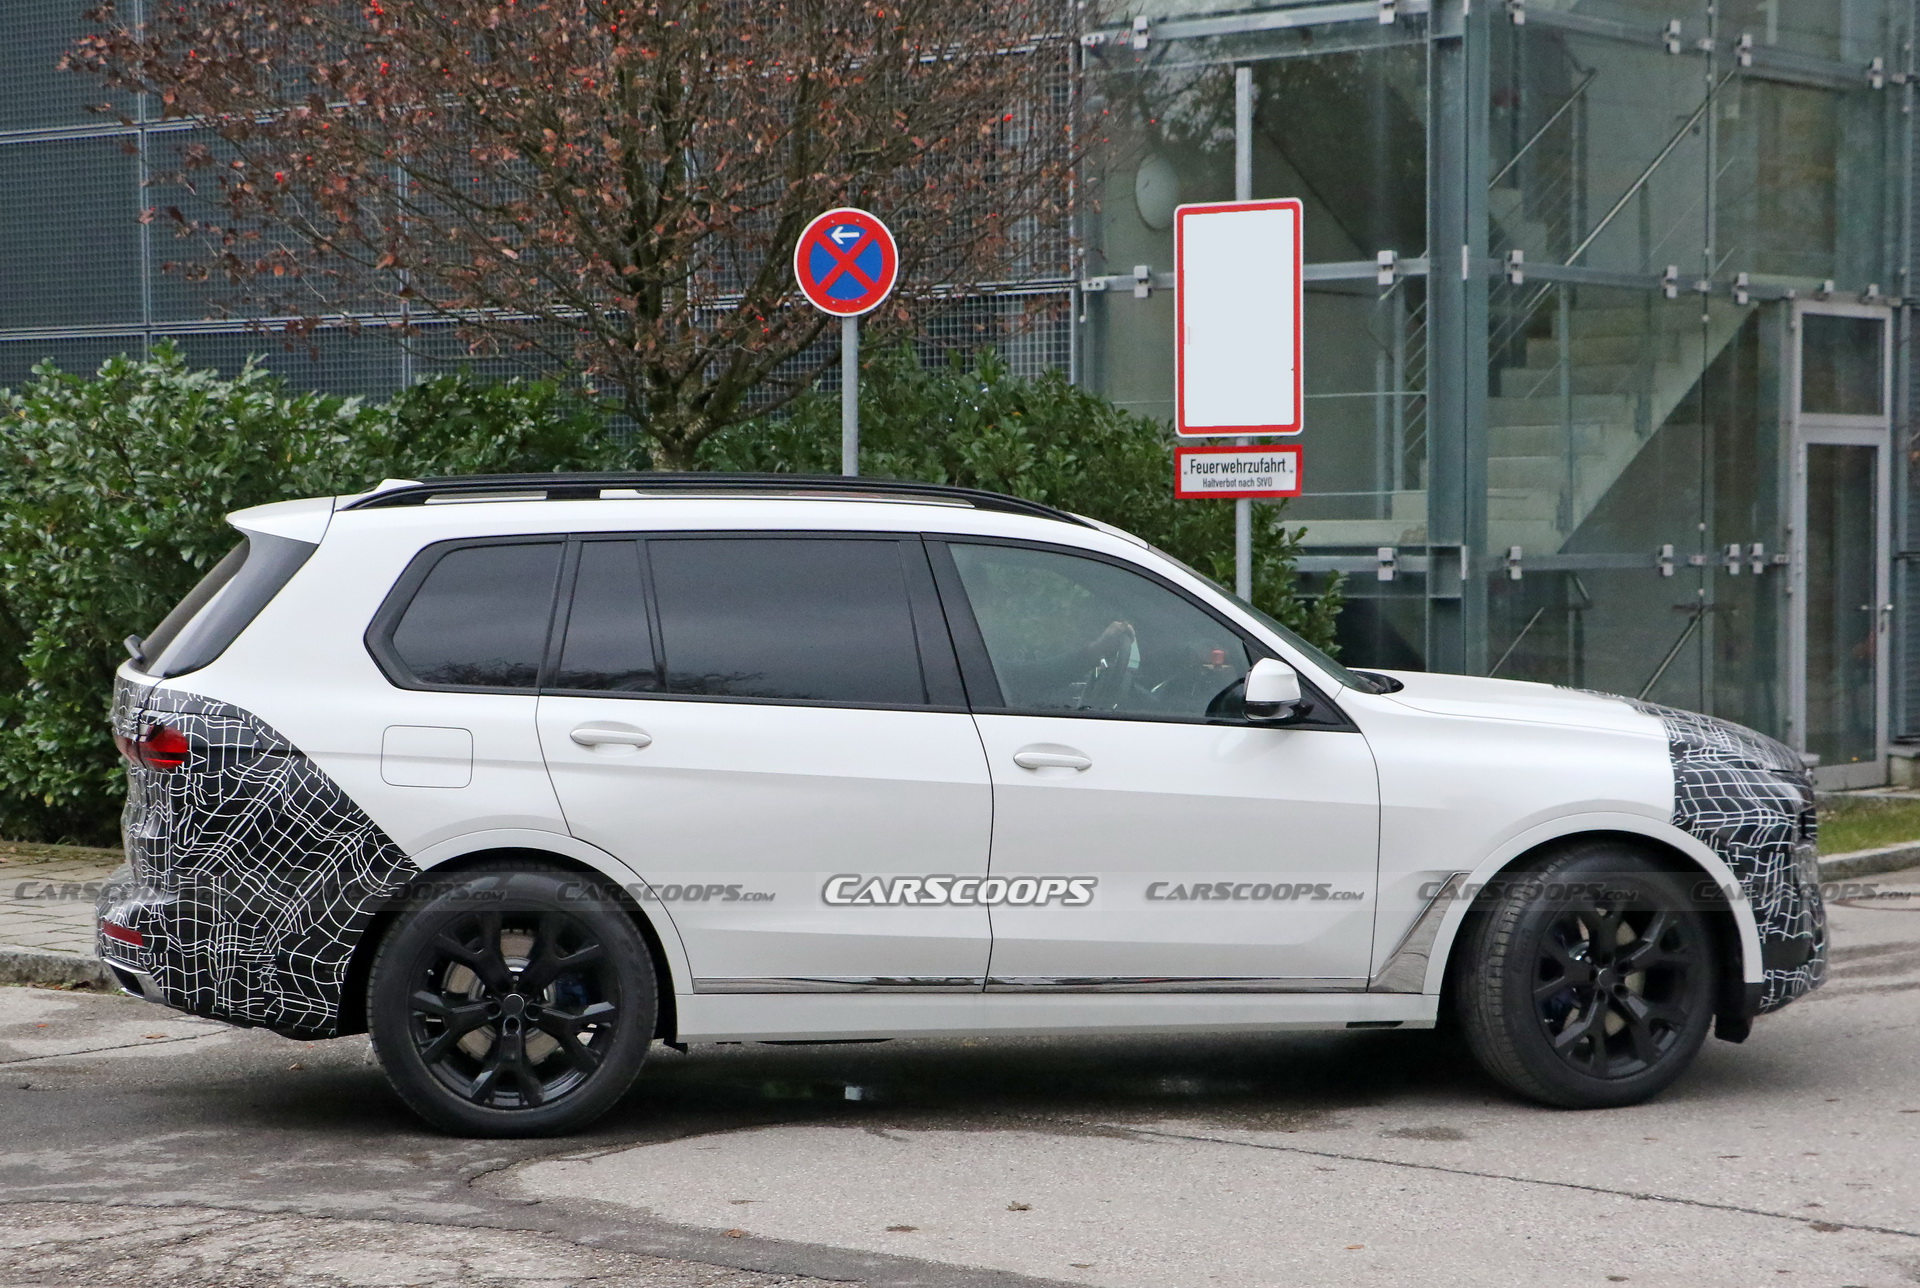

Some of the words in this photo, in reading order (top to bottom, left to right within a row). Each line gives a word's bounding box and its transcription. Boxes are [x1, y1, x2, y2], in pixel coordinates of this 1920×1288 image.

[1190, 458, 1286, 474] Feuerwehrzufahrt
[1202, 478, 1237, 488] Haltverbot
[1238, 478, 1255, 487] nach
[1256, 477, 1273, 487] StVO
